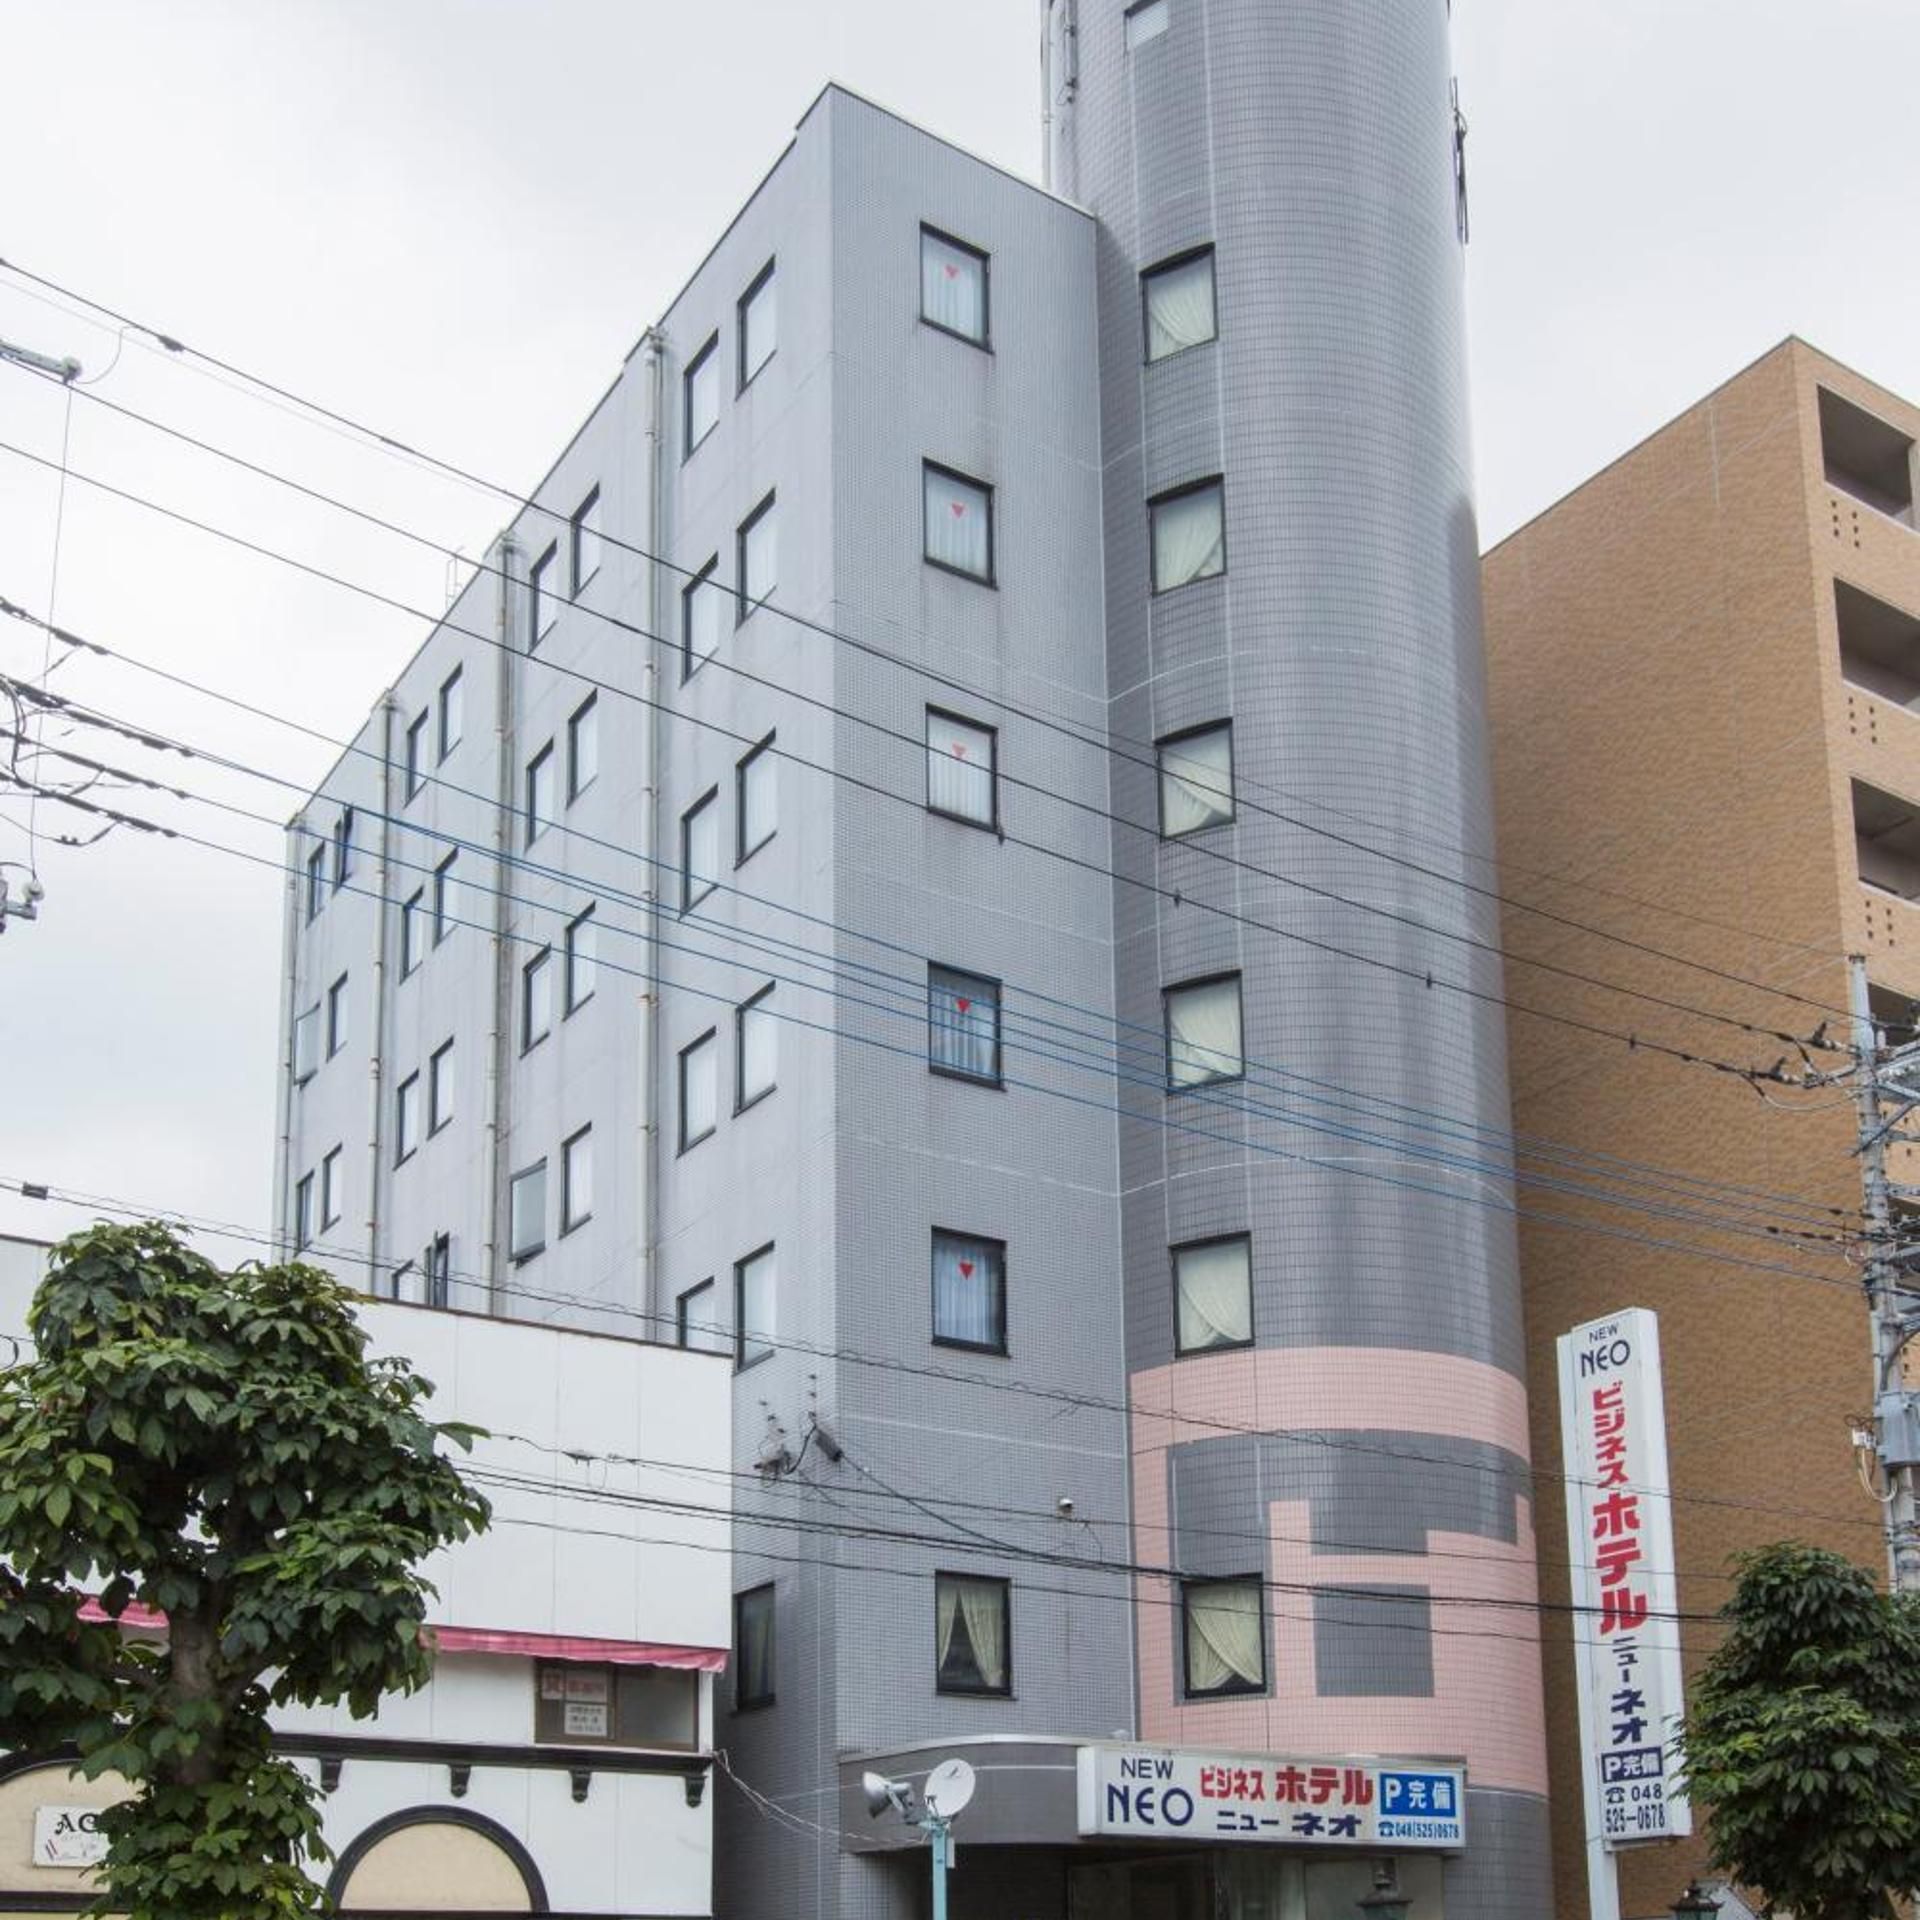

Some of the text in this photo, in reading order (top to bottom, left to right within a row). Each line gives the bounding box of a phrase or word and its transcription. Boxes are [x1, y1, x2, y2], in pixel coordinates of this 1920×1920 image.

[1589, 1323, 1620, 1343] NEW
[1581, 1340, 1631, 1377] NEO
[1121, 1757, 1174, 1780] NEW
[1631, 1783, 1663, 1802] 048
[1107, 1783, 1194, 1827] NEO
